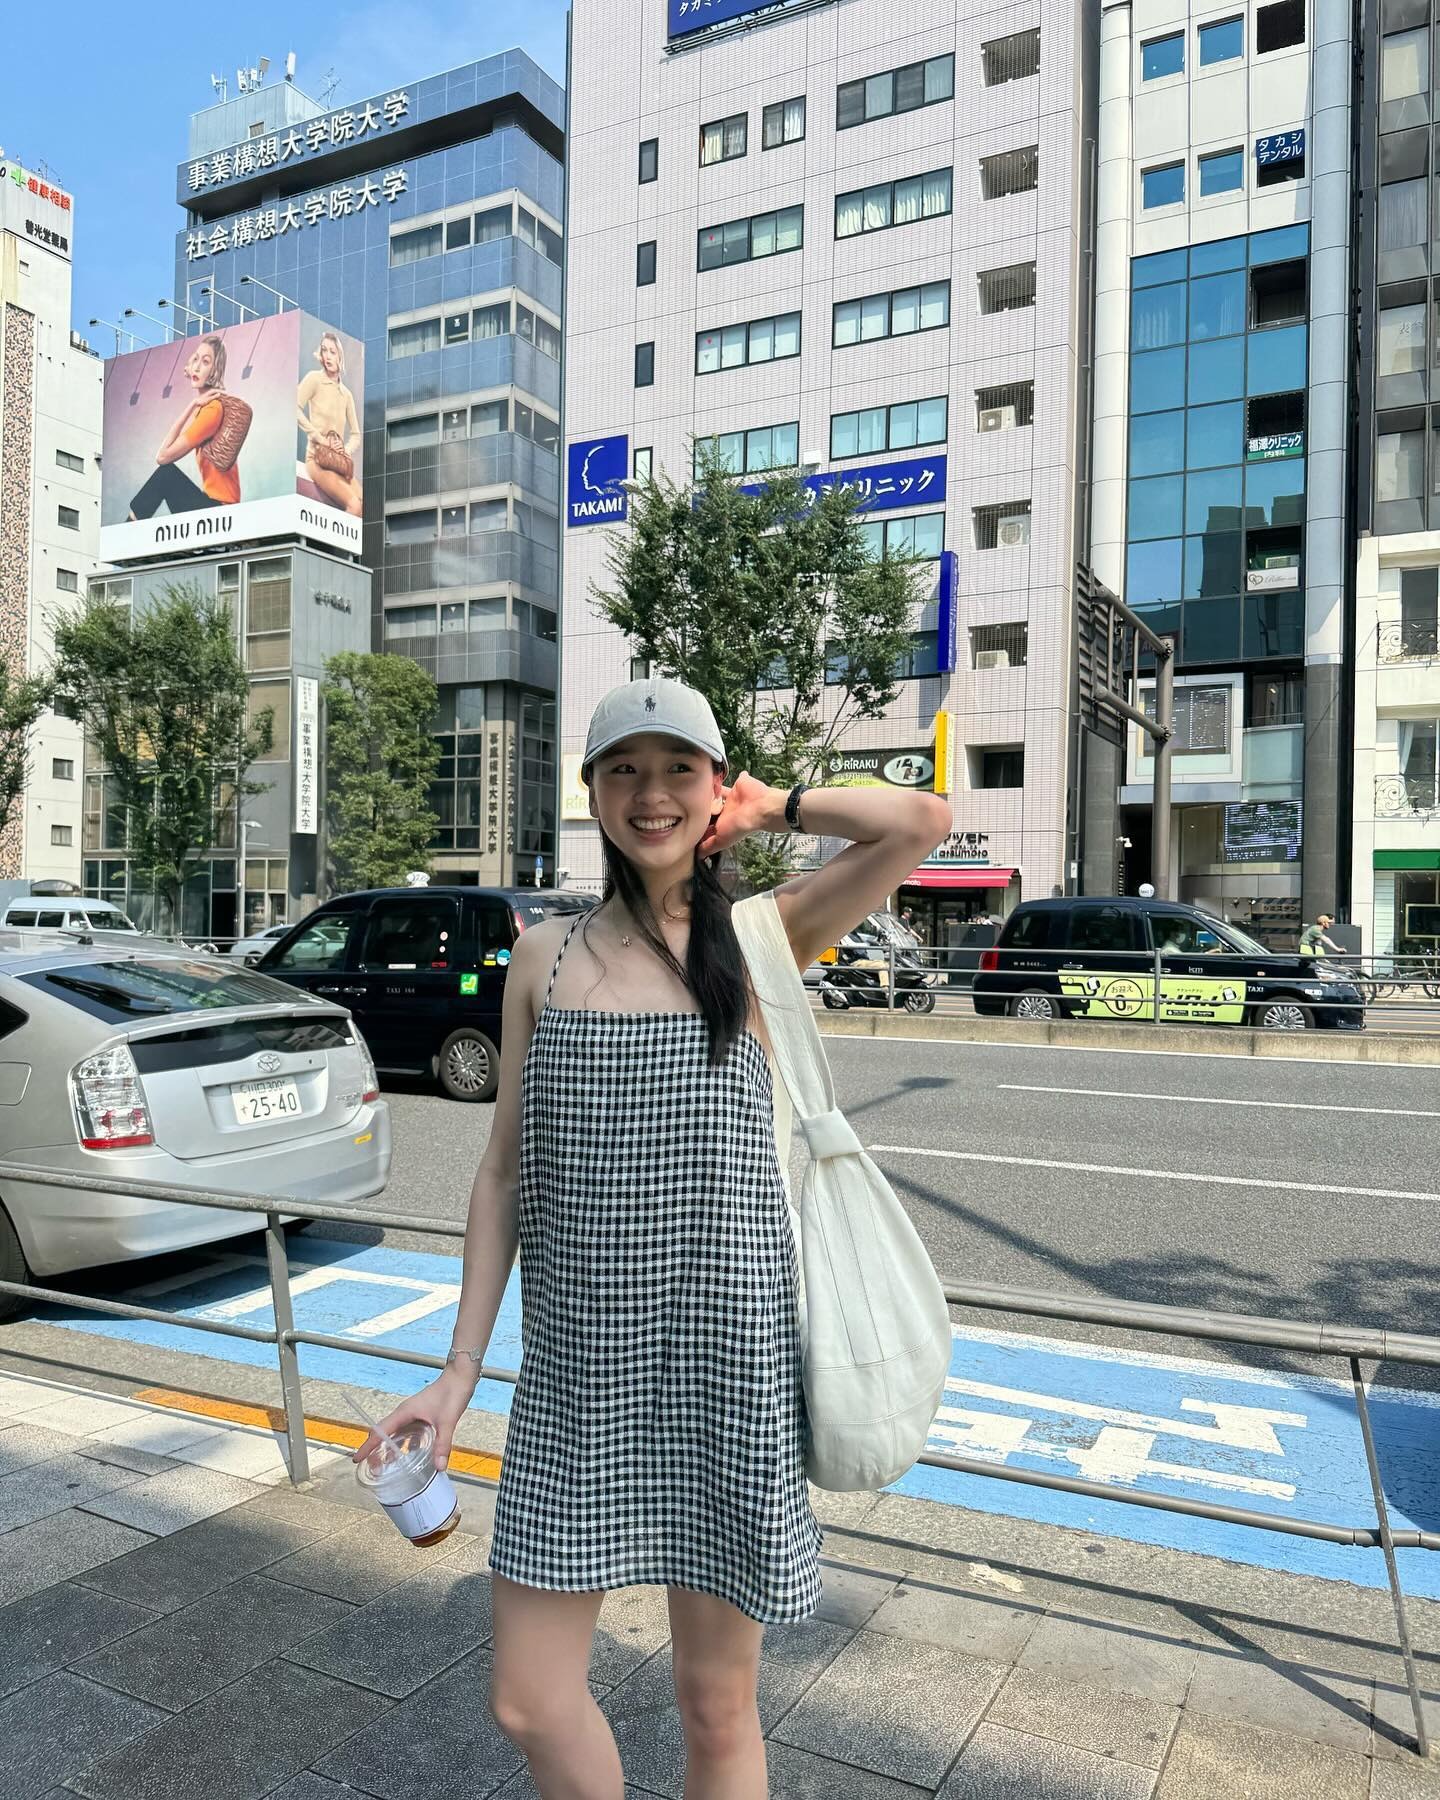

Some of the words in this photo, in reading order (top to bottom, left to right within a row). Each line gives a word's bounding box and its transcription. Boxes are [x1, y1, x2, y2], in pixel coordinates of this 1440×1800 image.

[187, 91, 409, 190] 事業構想大学院大学
[1258, 132, 1302, 152] タカシ
[185, 168, 408, 261] 社会構想大学院大学
[571, 497, 624, 517] TAKAMI
[1188, 966, 1203, 974] km
[1111, 985, 1133, 993] お迎え
[249, 1092, 297, 1118] 25-40
